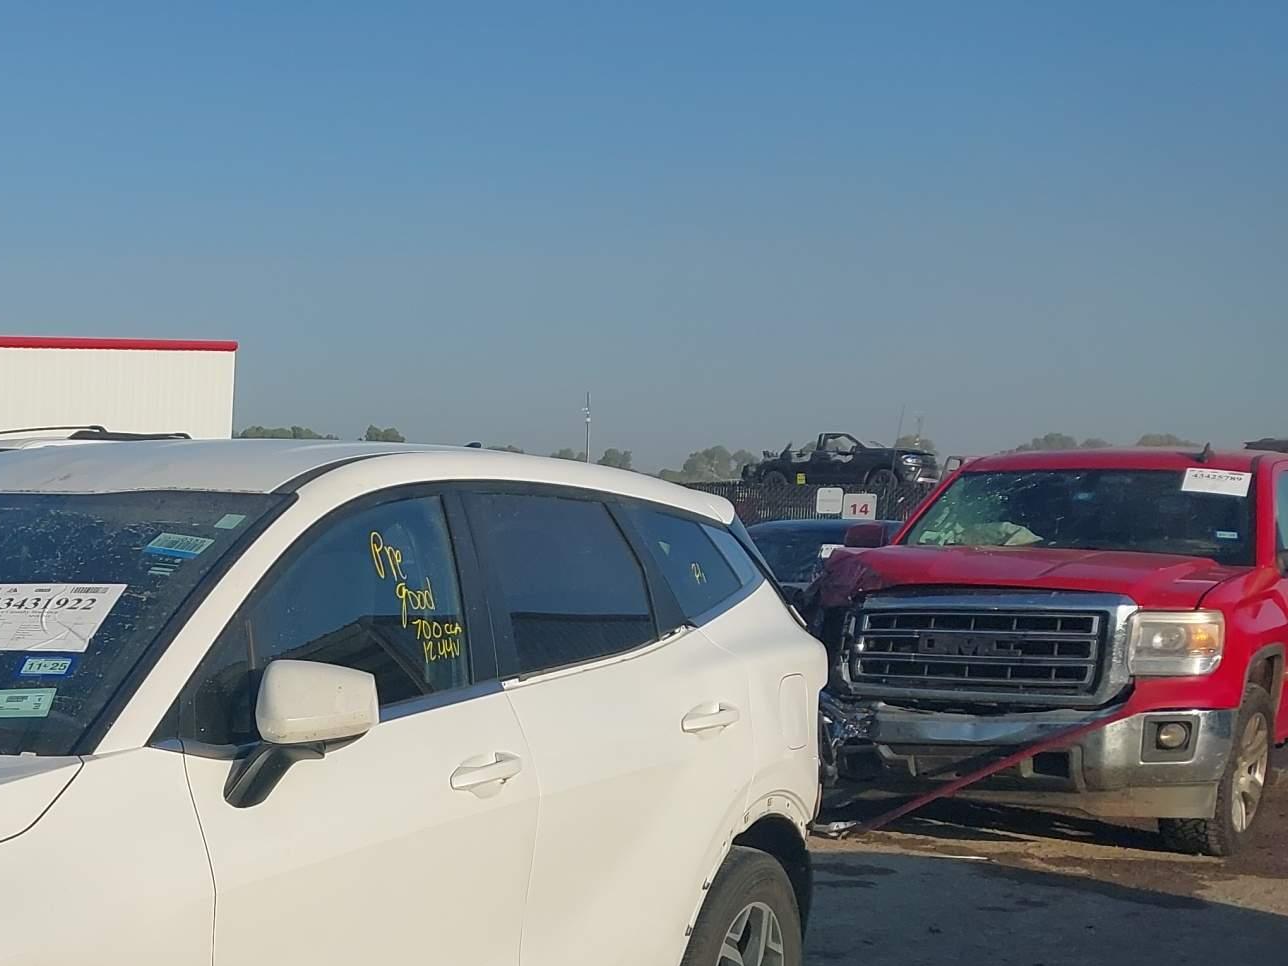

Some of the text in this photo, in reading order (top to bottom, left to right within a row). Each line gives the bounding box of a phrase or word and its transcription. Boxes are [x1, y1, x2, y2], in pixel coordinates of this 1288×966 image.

[850, 503, 869, 515] 14
[396, 576, 435, 628] good
[411, 619, 442, 640] 700
